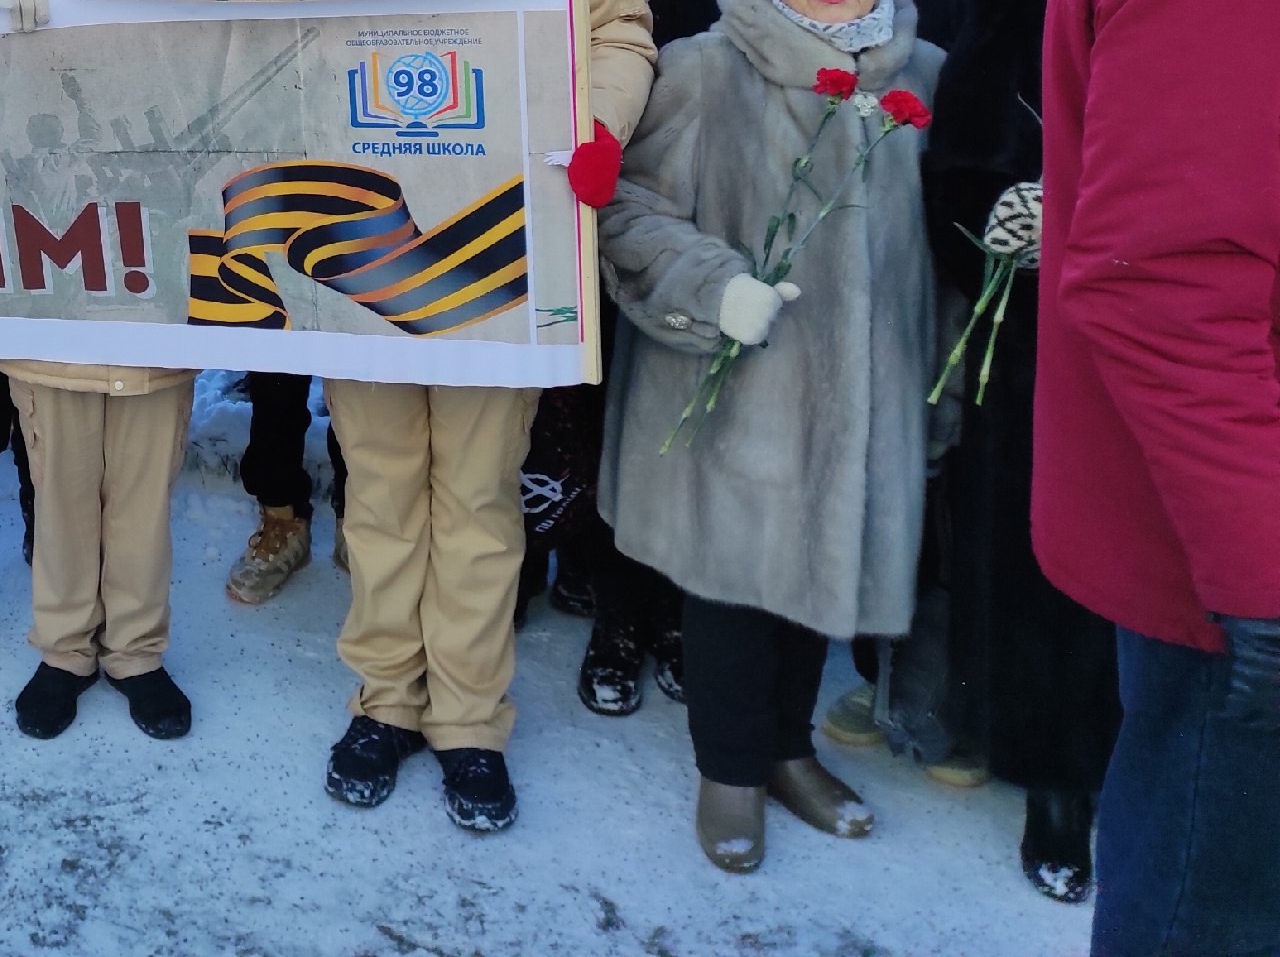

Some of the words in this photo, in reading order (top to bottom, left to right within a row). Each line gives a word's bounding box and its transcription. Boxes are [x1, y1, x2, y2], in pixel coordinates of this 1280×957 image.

[357, 29, 423, 38] МУНИЦИПАЛЬНОЕ
[423, 28, 469, 37] БЮДЖЕТНОЕ
[345, 38, 433, 47] ОБЩЕОБРАЗОВАТЕЛЬНОЕ
[435, 38, 482, 46] УЧРЕЖДЕНИЕ
[393, 69, 438, 97] 98
[351, 142, 423, 157] СРЕДНЯЯ
[426, 142, 487, 156] ШКОЛА
